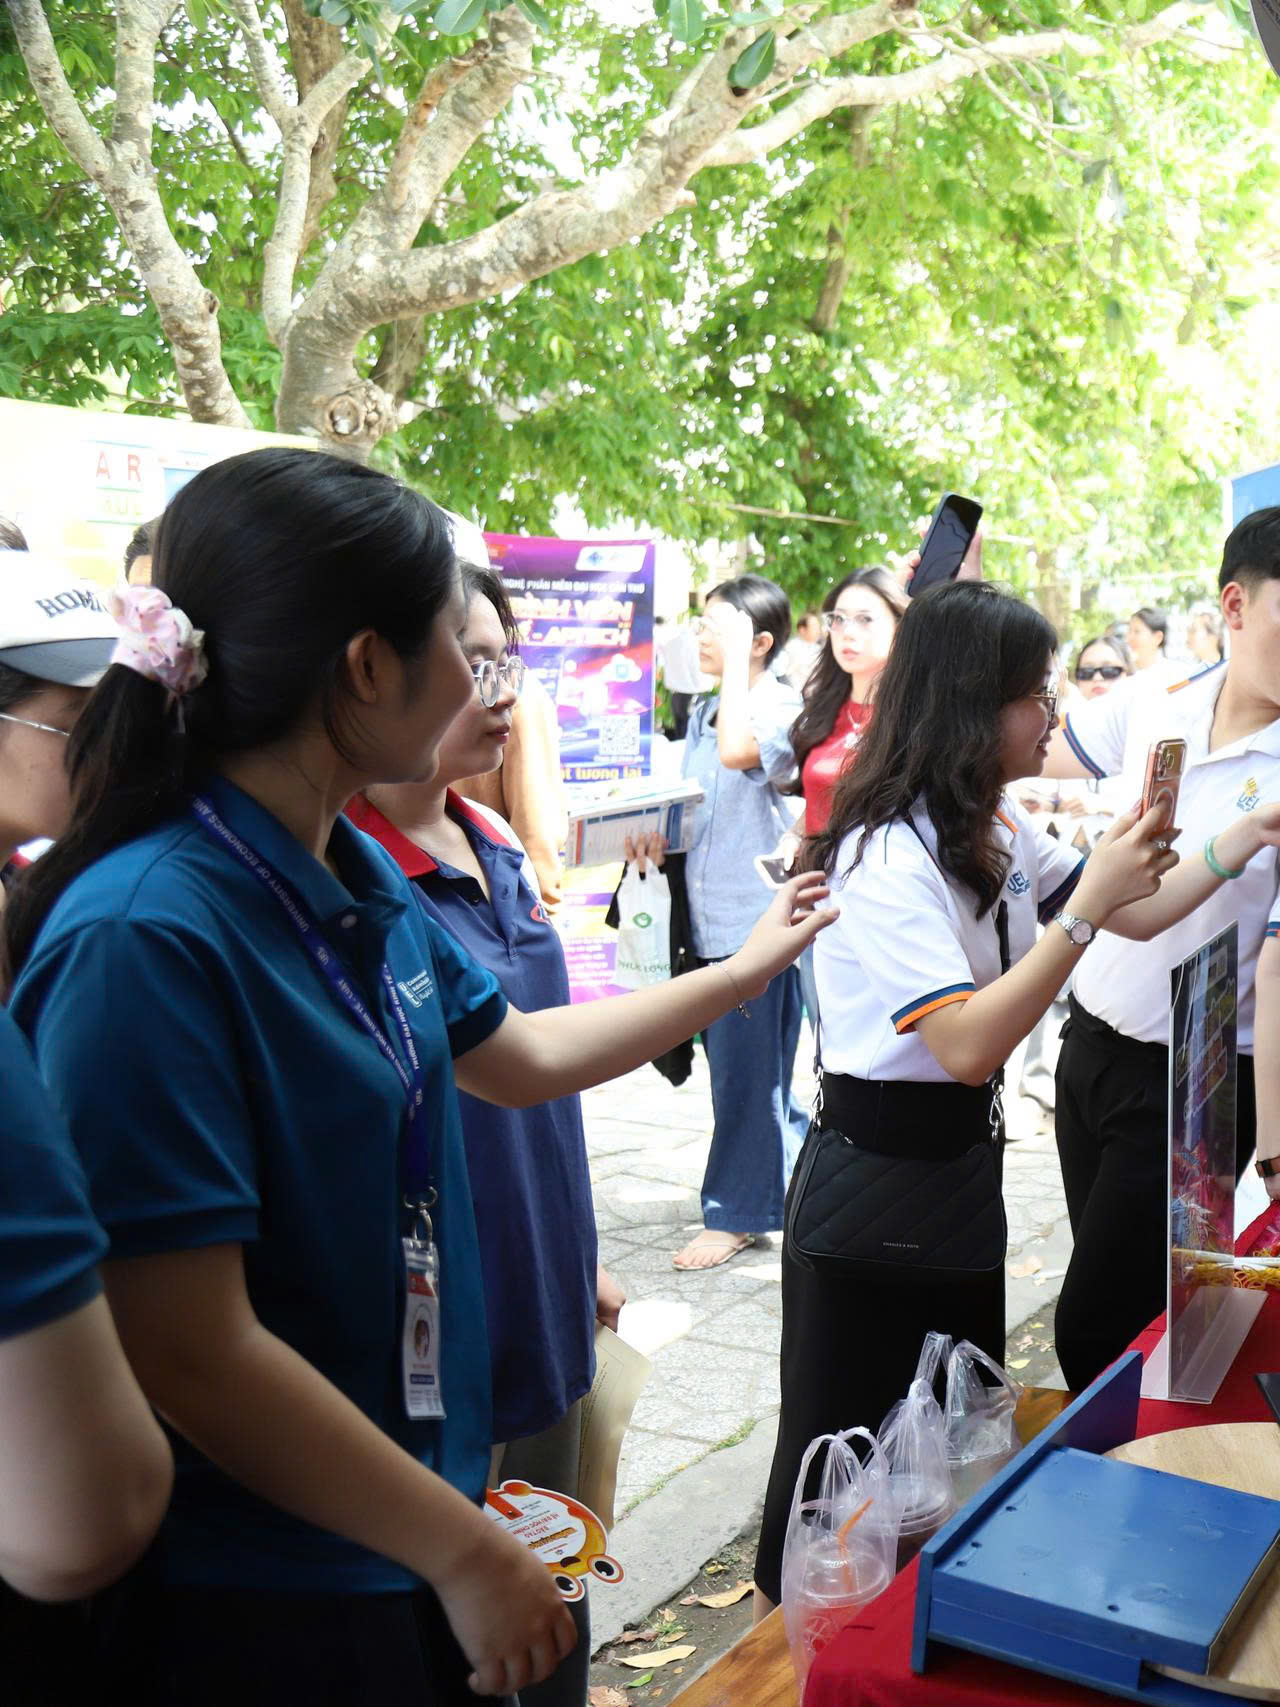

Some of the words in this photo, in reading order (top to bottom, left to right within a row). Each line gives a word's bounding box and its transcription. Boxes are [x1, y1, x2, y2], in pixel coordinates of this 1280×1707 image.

[207, 813, 259, 869] ECONOMICS
[268, 876, 311, 933] UNIVERSITY
[1007, 870, 1029, 893] UEL
